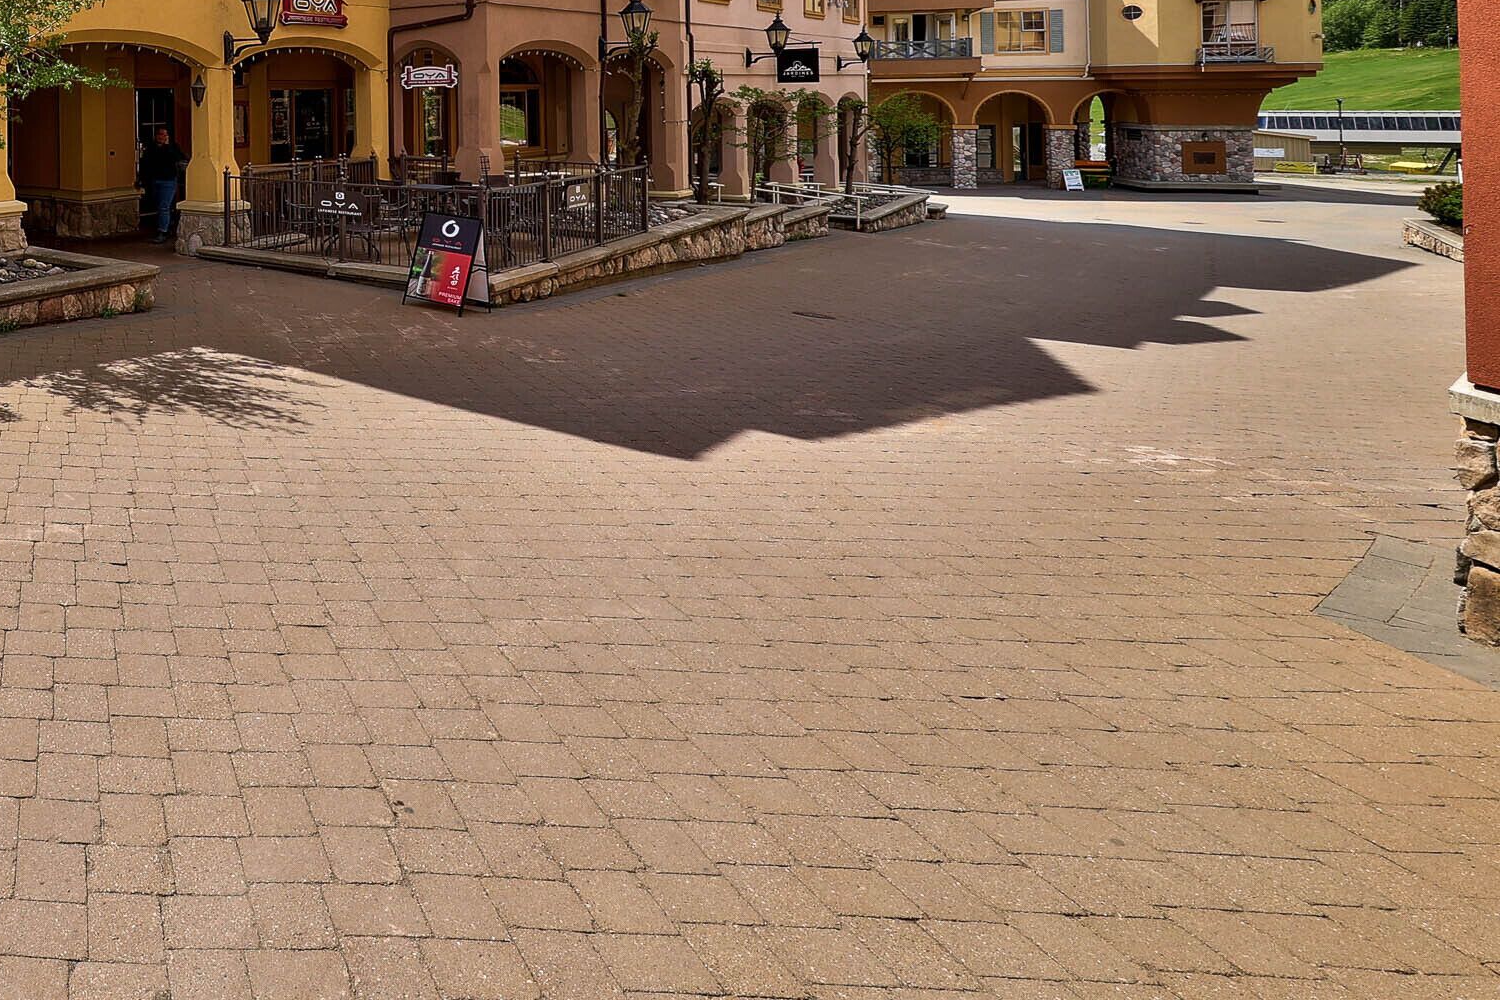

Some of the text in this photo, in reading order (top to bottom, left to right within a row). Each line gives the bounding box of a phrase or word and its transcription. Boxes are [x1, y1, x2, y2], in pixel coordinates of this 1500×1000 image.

[569, 194, 586, 202] OYA
[320, 200, 358, 210] OYA
[438, 291, 462, 300] PREMIUM
